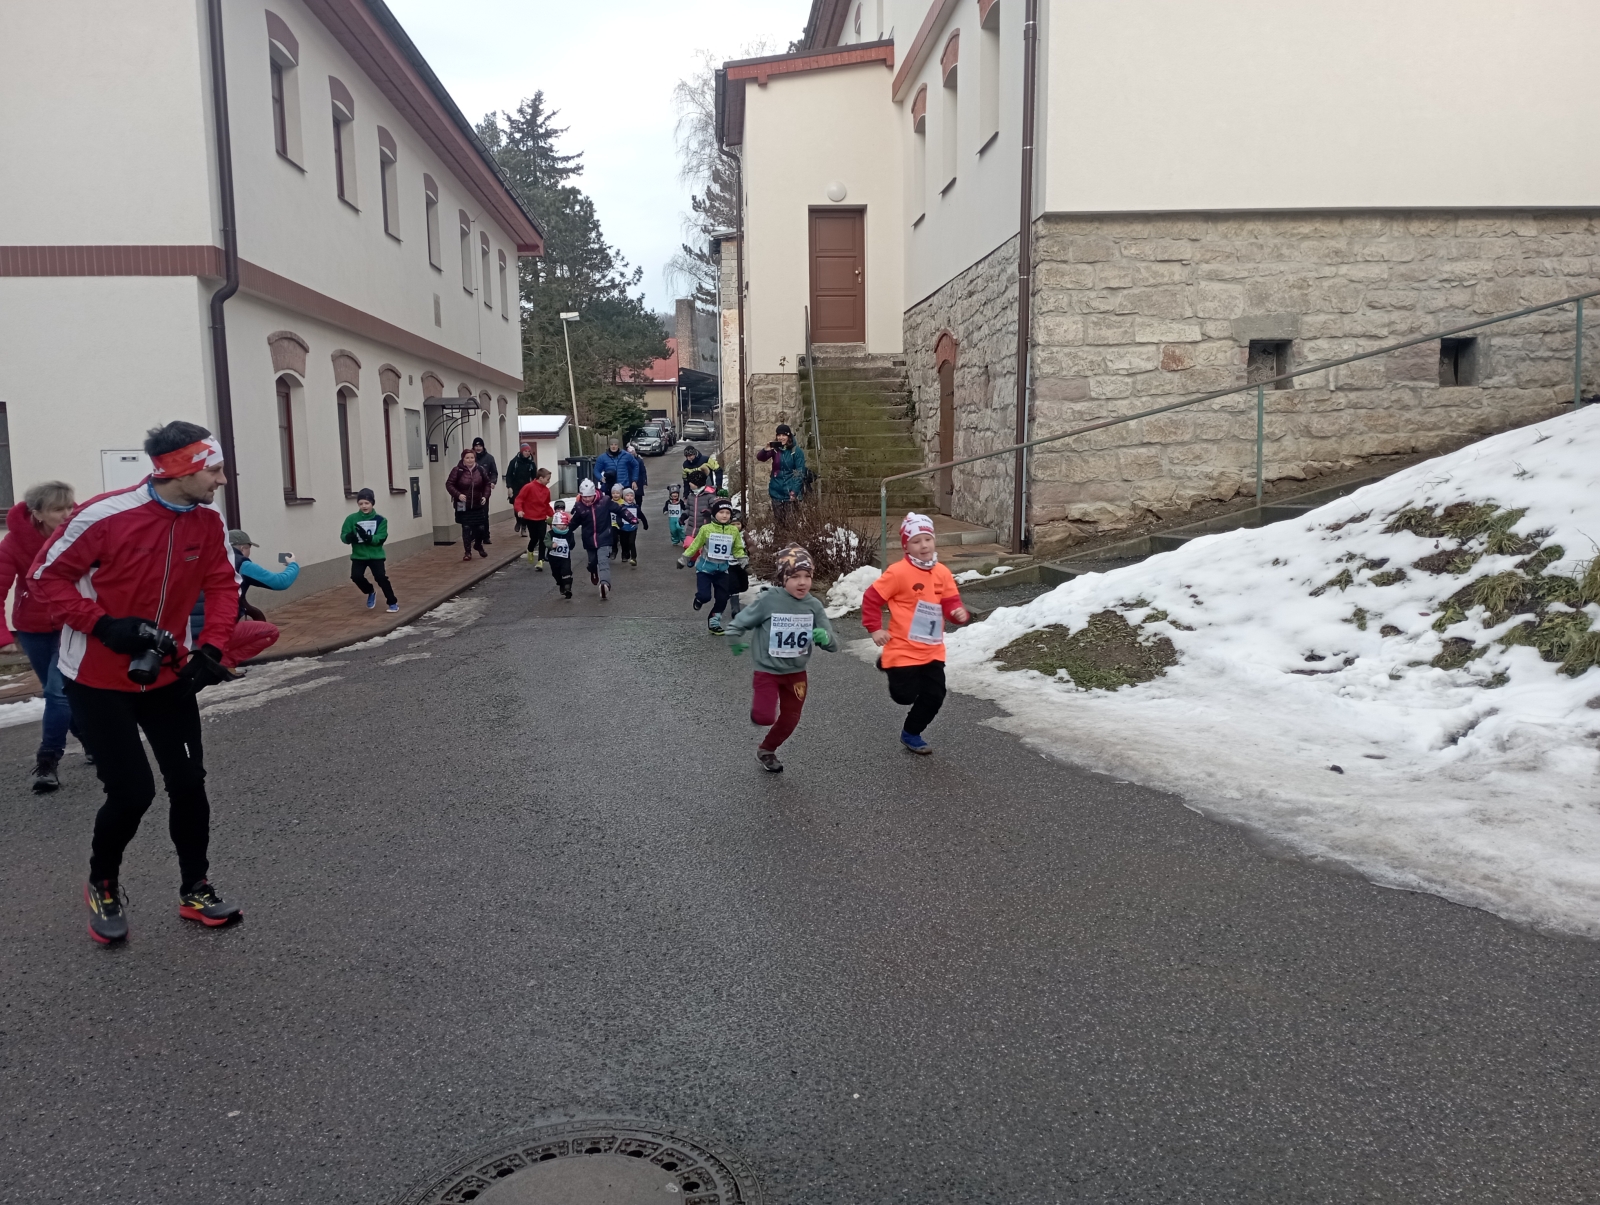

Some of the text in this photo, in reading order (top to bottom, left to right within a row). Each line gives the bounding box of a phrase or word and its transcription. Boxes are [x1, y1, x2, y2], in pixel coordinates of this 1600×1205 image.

[713, 543, 728, 555] 59
[928, 620, 936, 637] 1
[775, 631, 808, 649] 146
